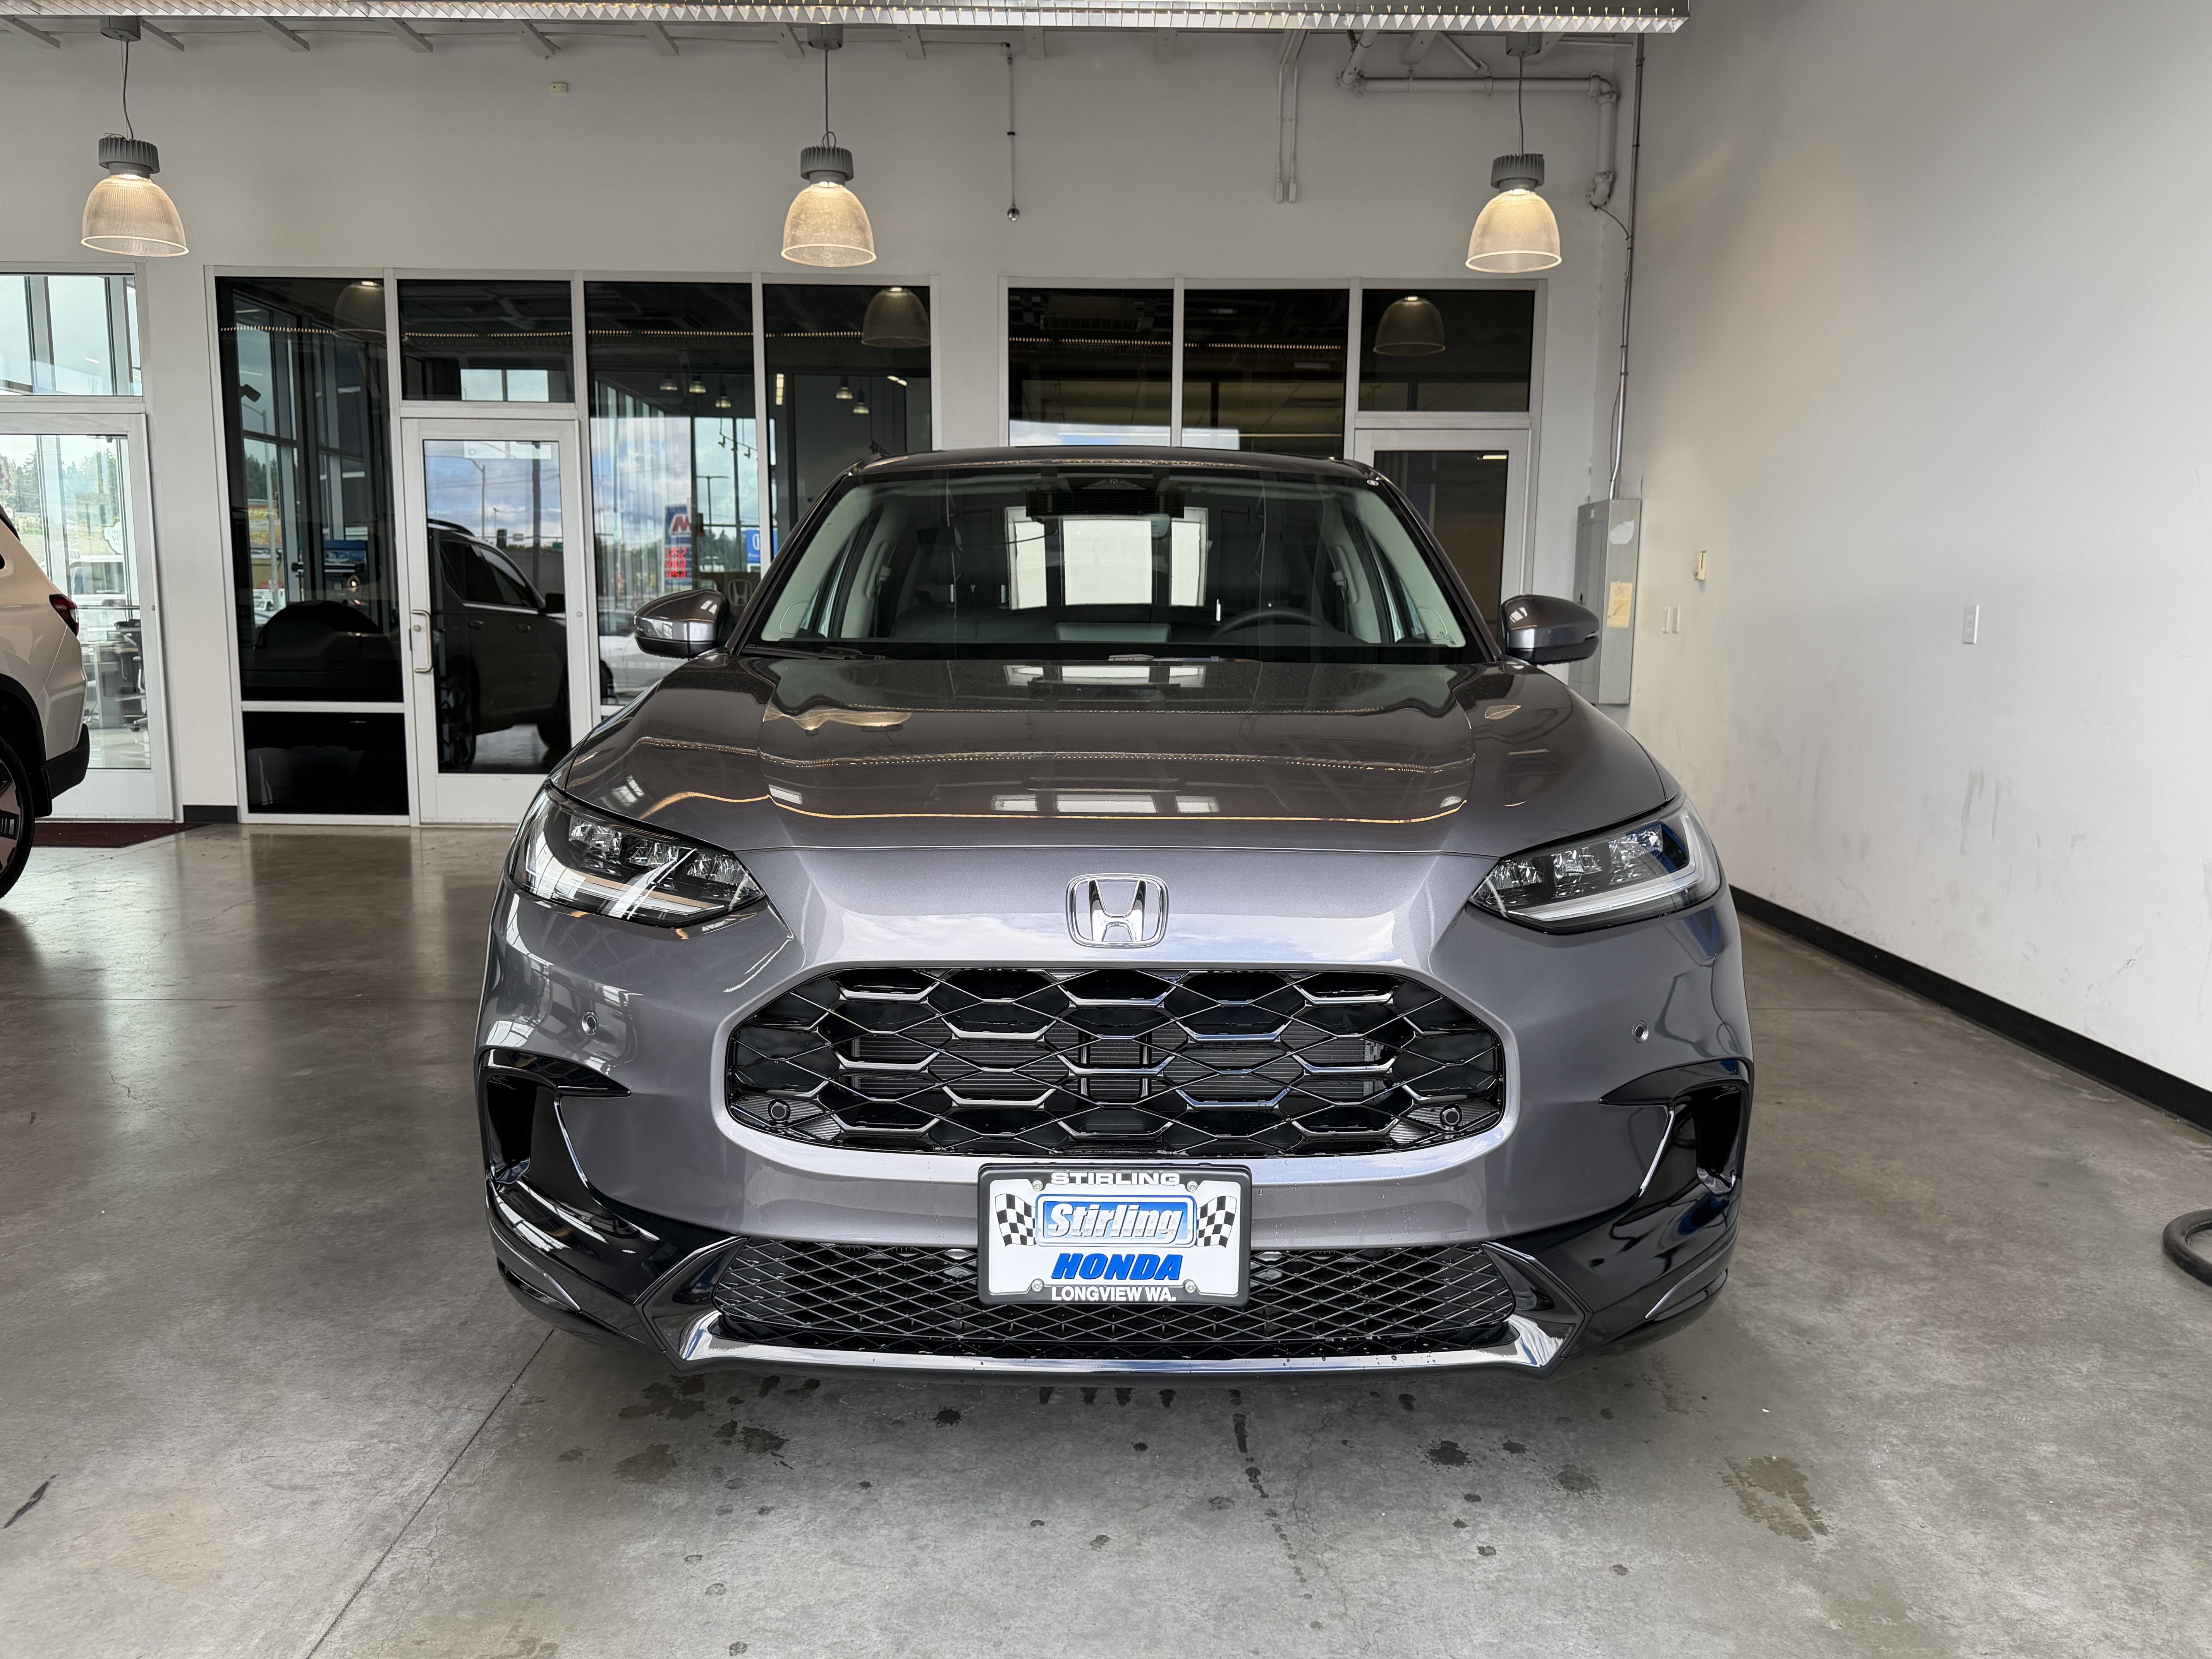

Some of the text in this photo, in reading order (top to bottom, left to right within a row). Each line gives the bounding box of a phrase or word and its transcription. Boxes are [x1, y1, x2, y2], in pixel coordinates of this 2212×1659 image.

[1051, 1171, 1180, 1185] STIRLING
[1048, 1203, 1184, 1243] Stirling
[1051, 1253, 1183, 1280] HONDA
[1051, 1286, 1176, 1301] LONGVIEW WA.
